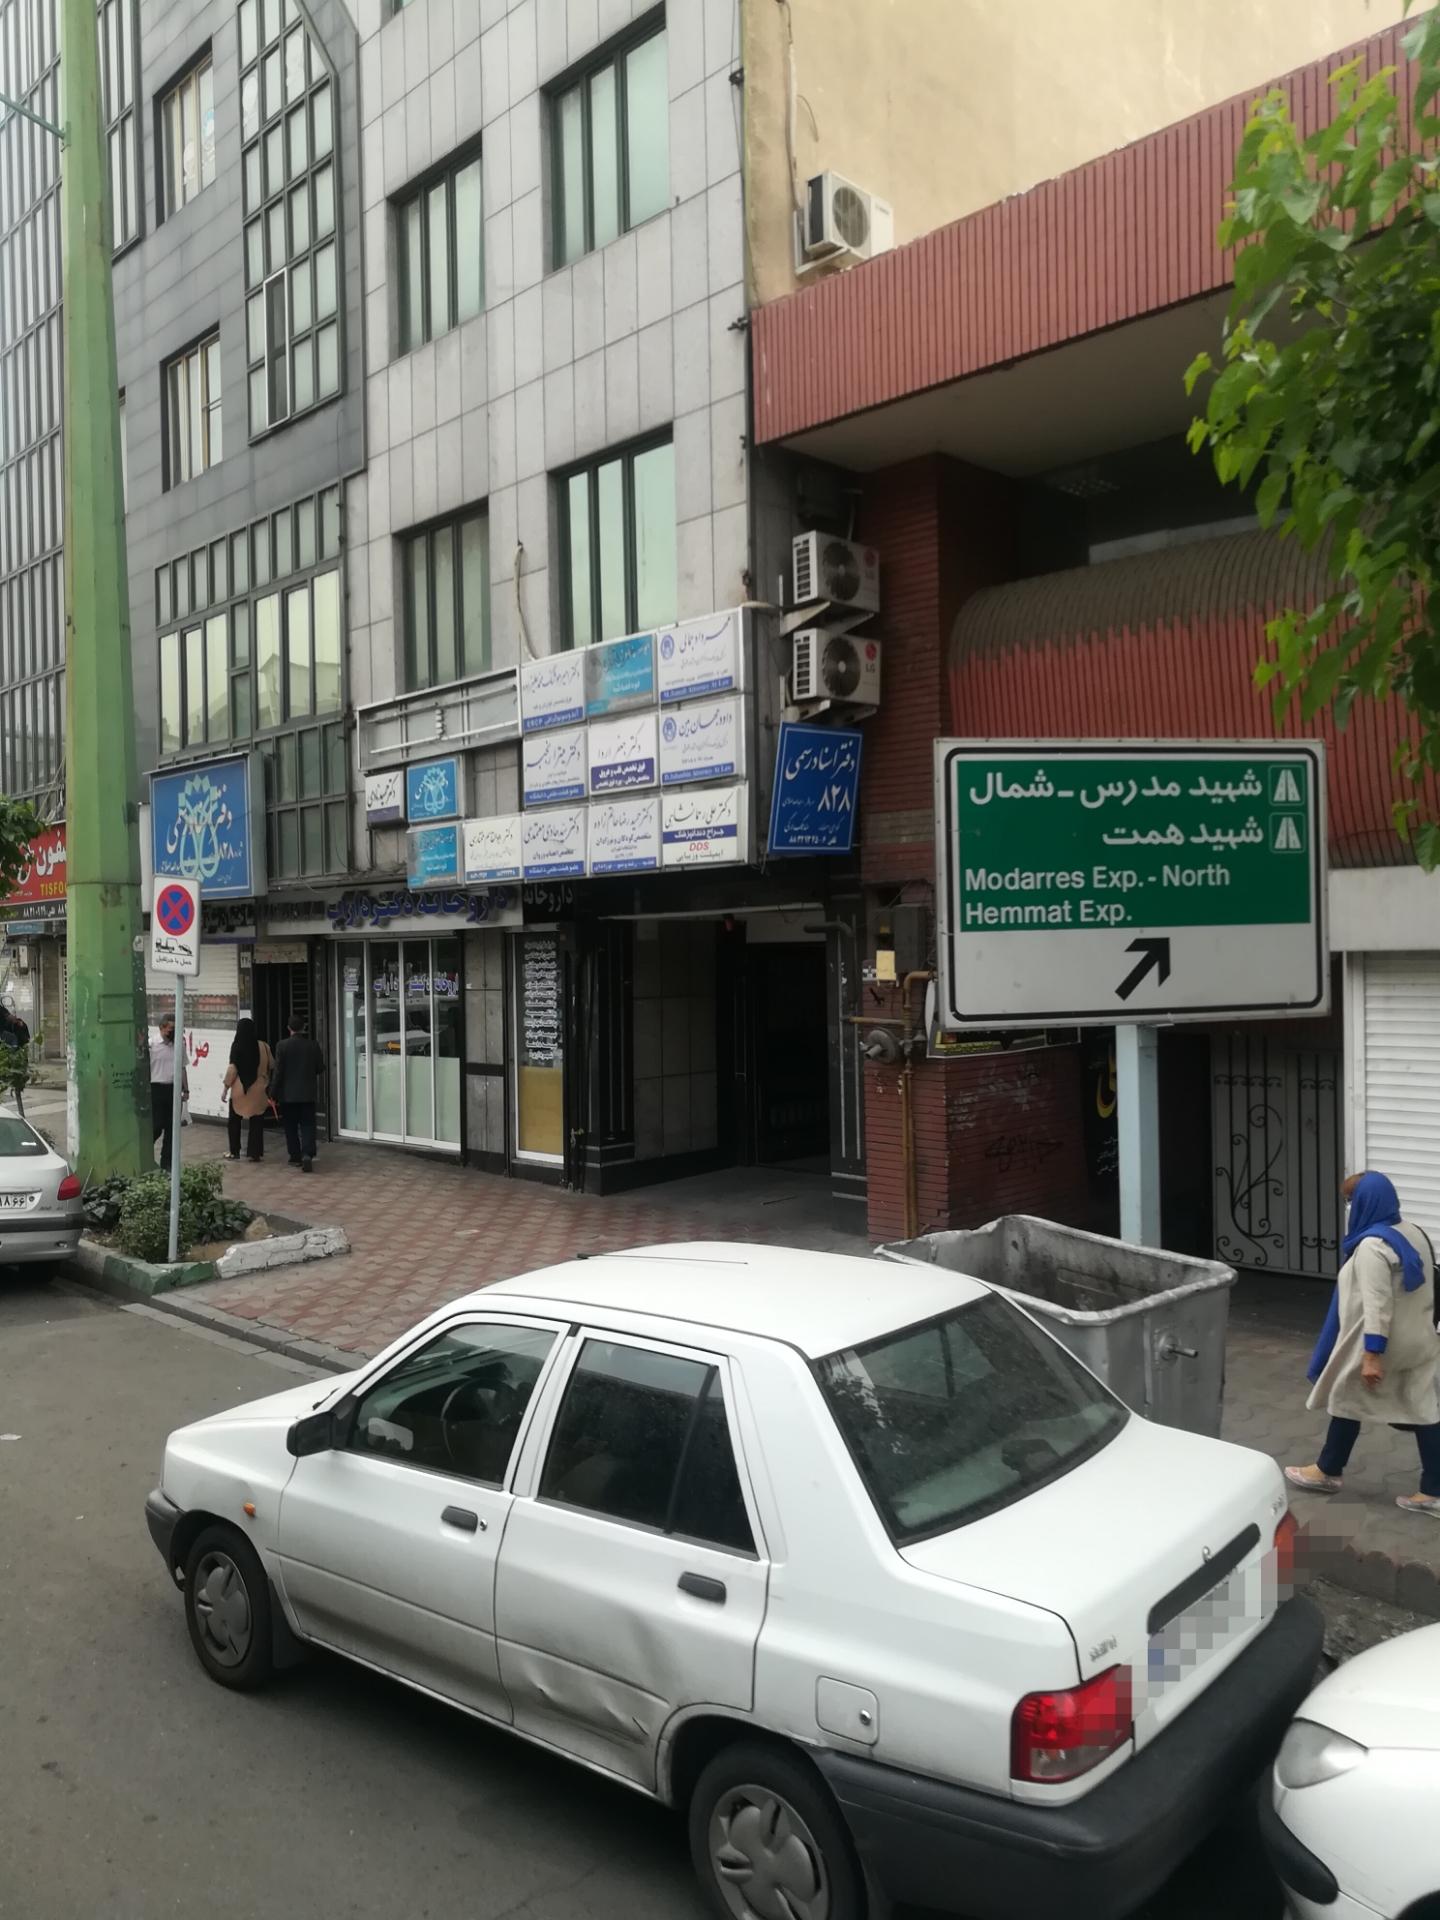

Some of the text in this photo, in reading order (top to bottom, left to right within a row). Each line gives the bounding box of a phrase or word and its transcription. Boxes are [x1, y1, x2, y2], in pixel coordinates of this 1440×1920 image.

[866, 663, 875, 673] LG
[566, 733, 581, 767] دکتر
[626, 720, 645, 758] دکتر
[830, 740, 855, 779] دفتر
[817, 783, 851, 813] ۸۲۸
[969, 768, 1055, 806] شمال
[1080, 775, 1181, 808] مدرس
[1188, 768, 1263, 803] شهید
[640, 800, 655, 827] دکتر
[717, 791, 734, 820] دکتر
[689, 841, 710, 852] DDS
[1102, 816, 1264, 851] شهید همت
[40, 881, 66, 897] TISFO
[965, 867, 1085, 891] Modarres
[1092, 865, 1145, 892] Exp.
[1162, 864, 1230, 887] North
[524, 883, 573, 912] داروخانه
[965, 900, 1133, 926] Hemmat Exp.
[180, 958, 192, 966] حمل
